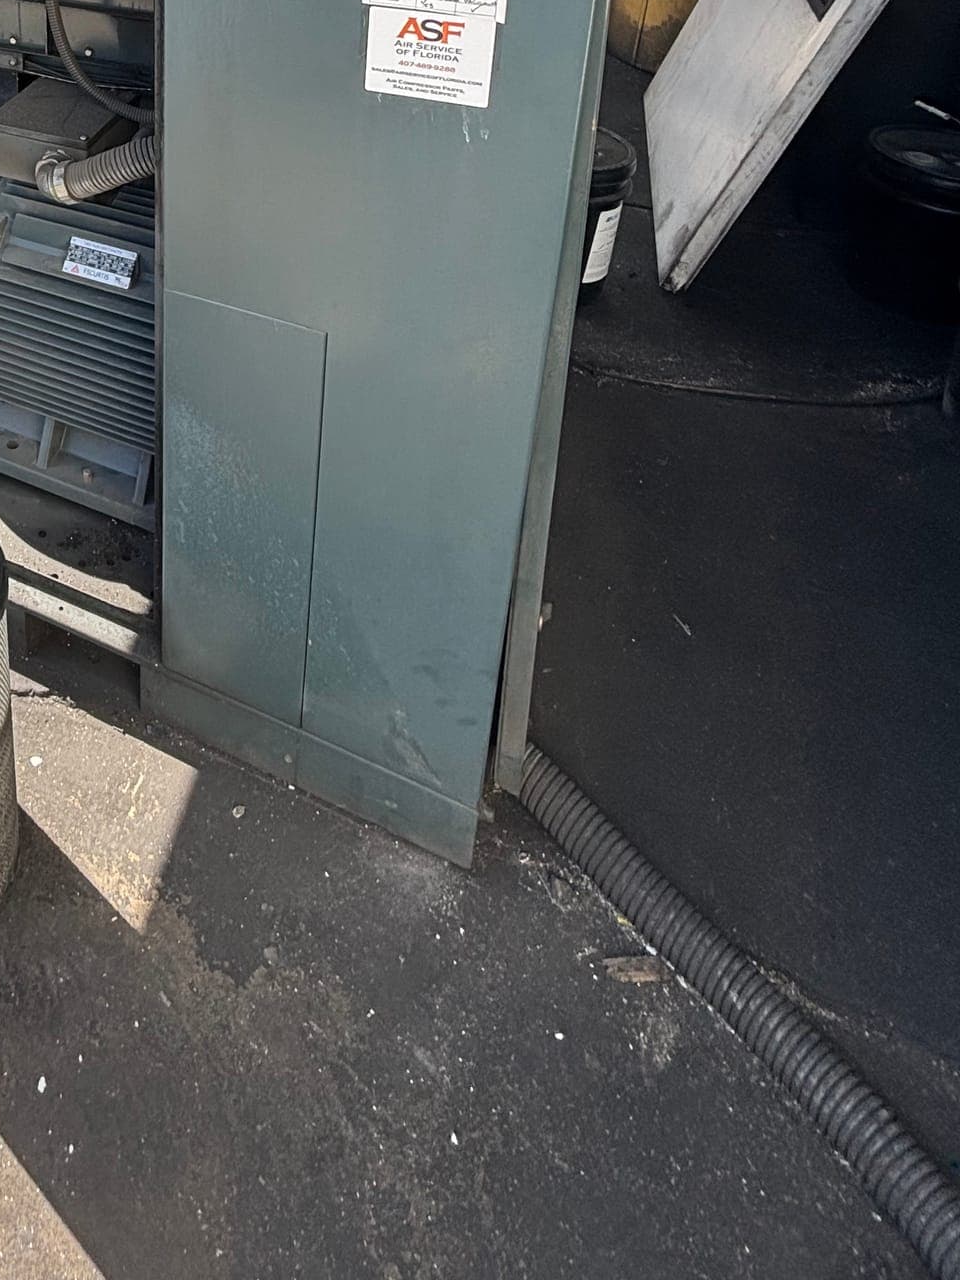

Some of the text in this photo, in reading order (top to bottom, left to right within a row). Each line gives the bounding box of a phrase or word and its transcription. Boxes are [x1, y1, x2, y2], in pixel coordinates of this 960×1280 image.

[396, 17, 465, 44] ASF
[394, 40, 462, 55] AIR SERVICE
[396, 48, 459, 62] OF FLORIDA
